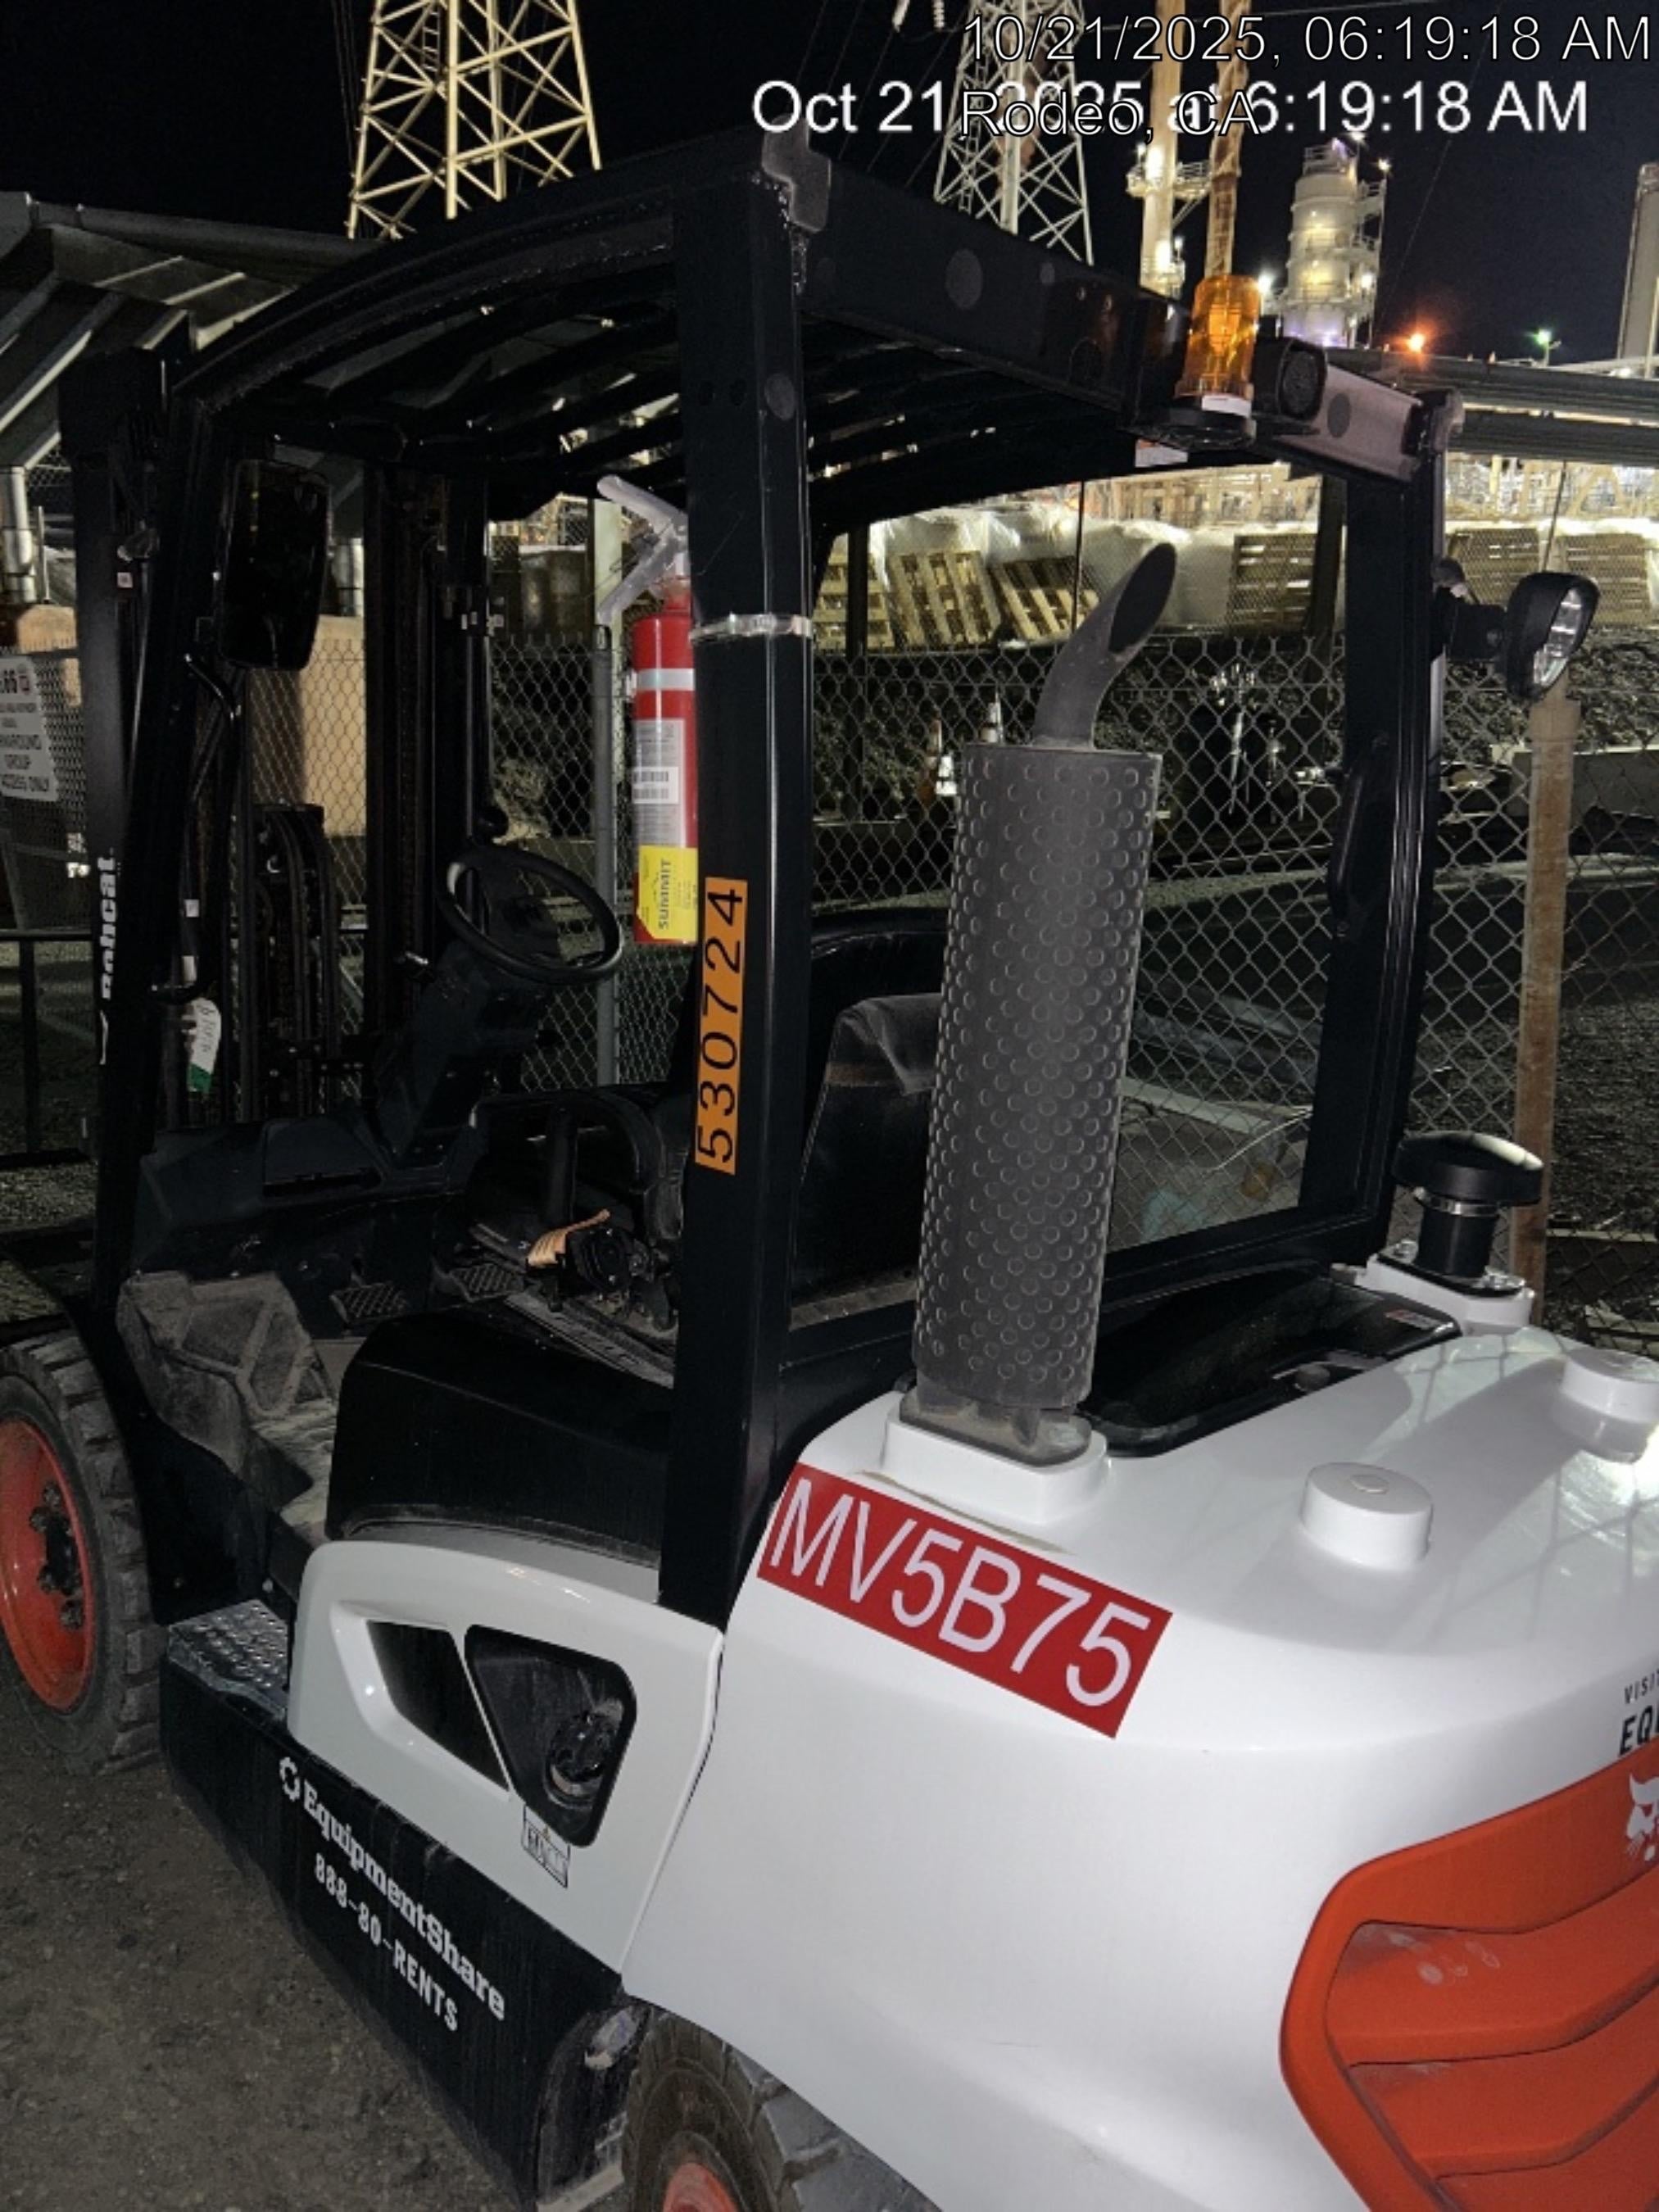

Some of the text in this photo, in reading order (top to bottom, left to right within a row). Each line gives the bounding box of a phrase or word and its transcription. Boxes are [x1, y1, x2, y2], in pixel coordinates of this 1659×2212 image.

[658, 859, 671, 930] SUMMIT
[697, 889, 743, 1164] 530724
[769, 1479, 1151, 1707] MV5B75
[303, 1778, 505, 2021] EquipmentShare
[315, 1852, 458, 2032] 888-80-RENTS
